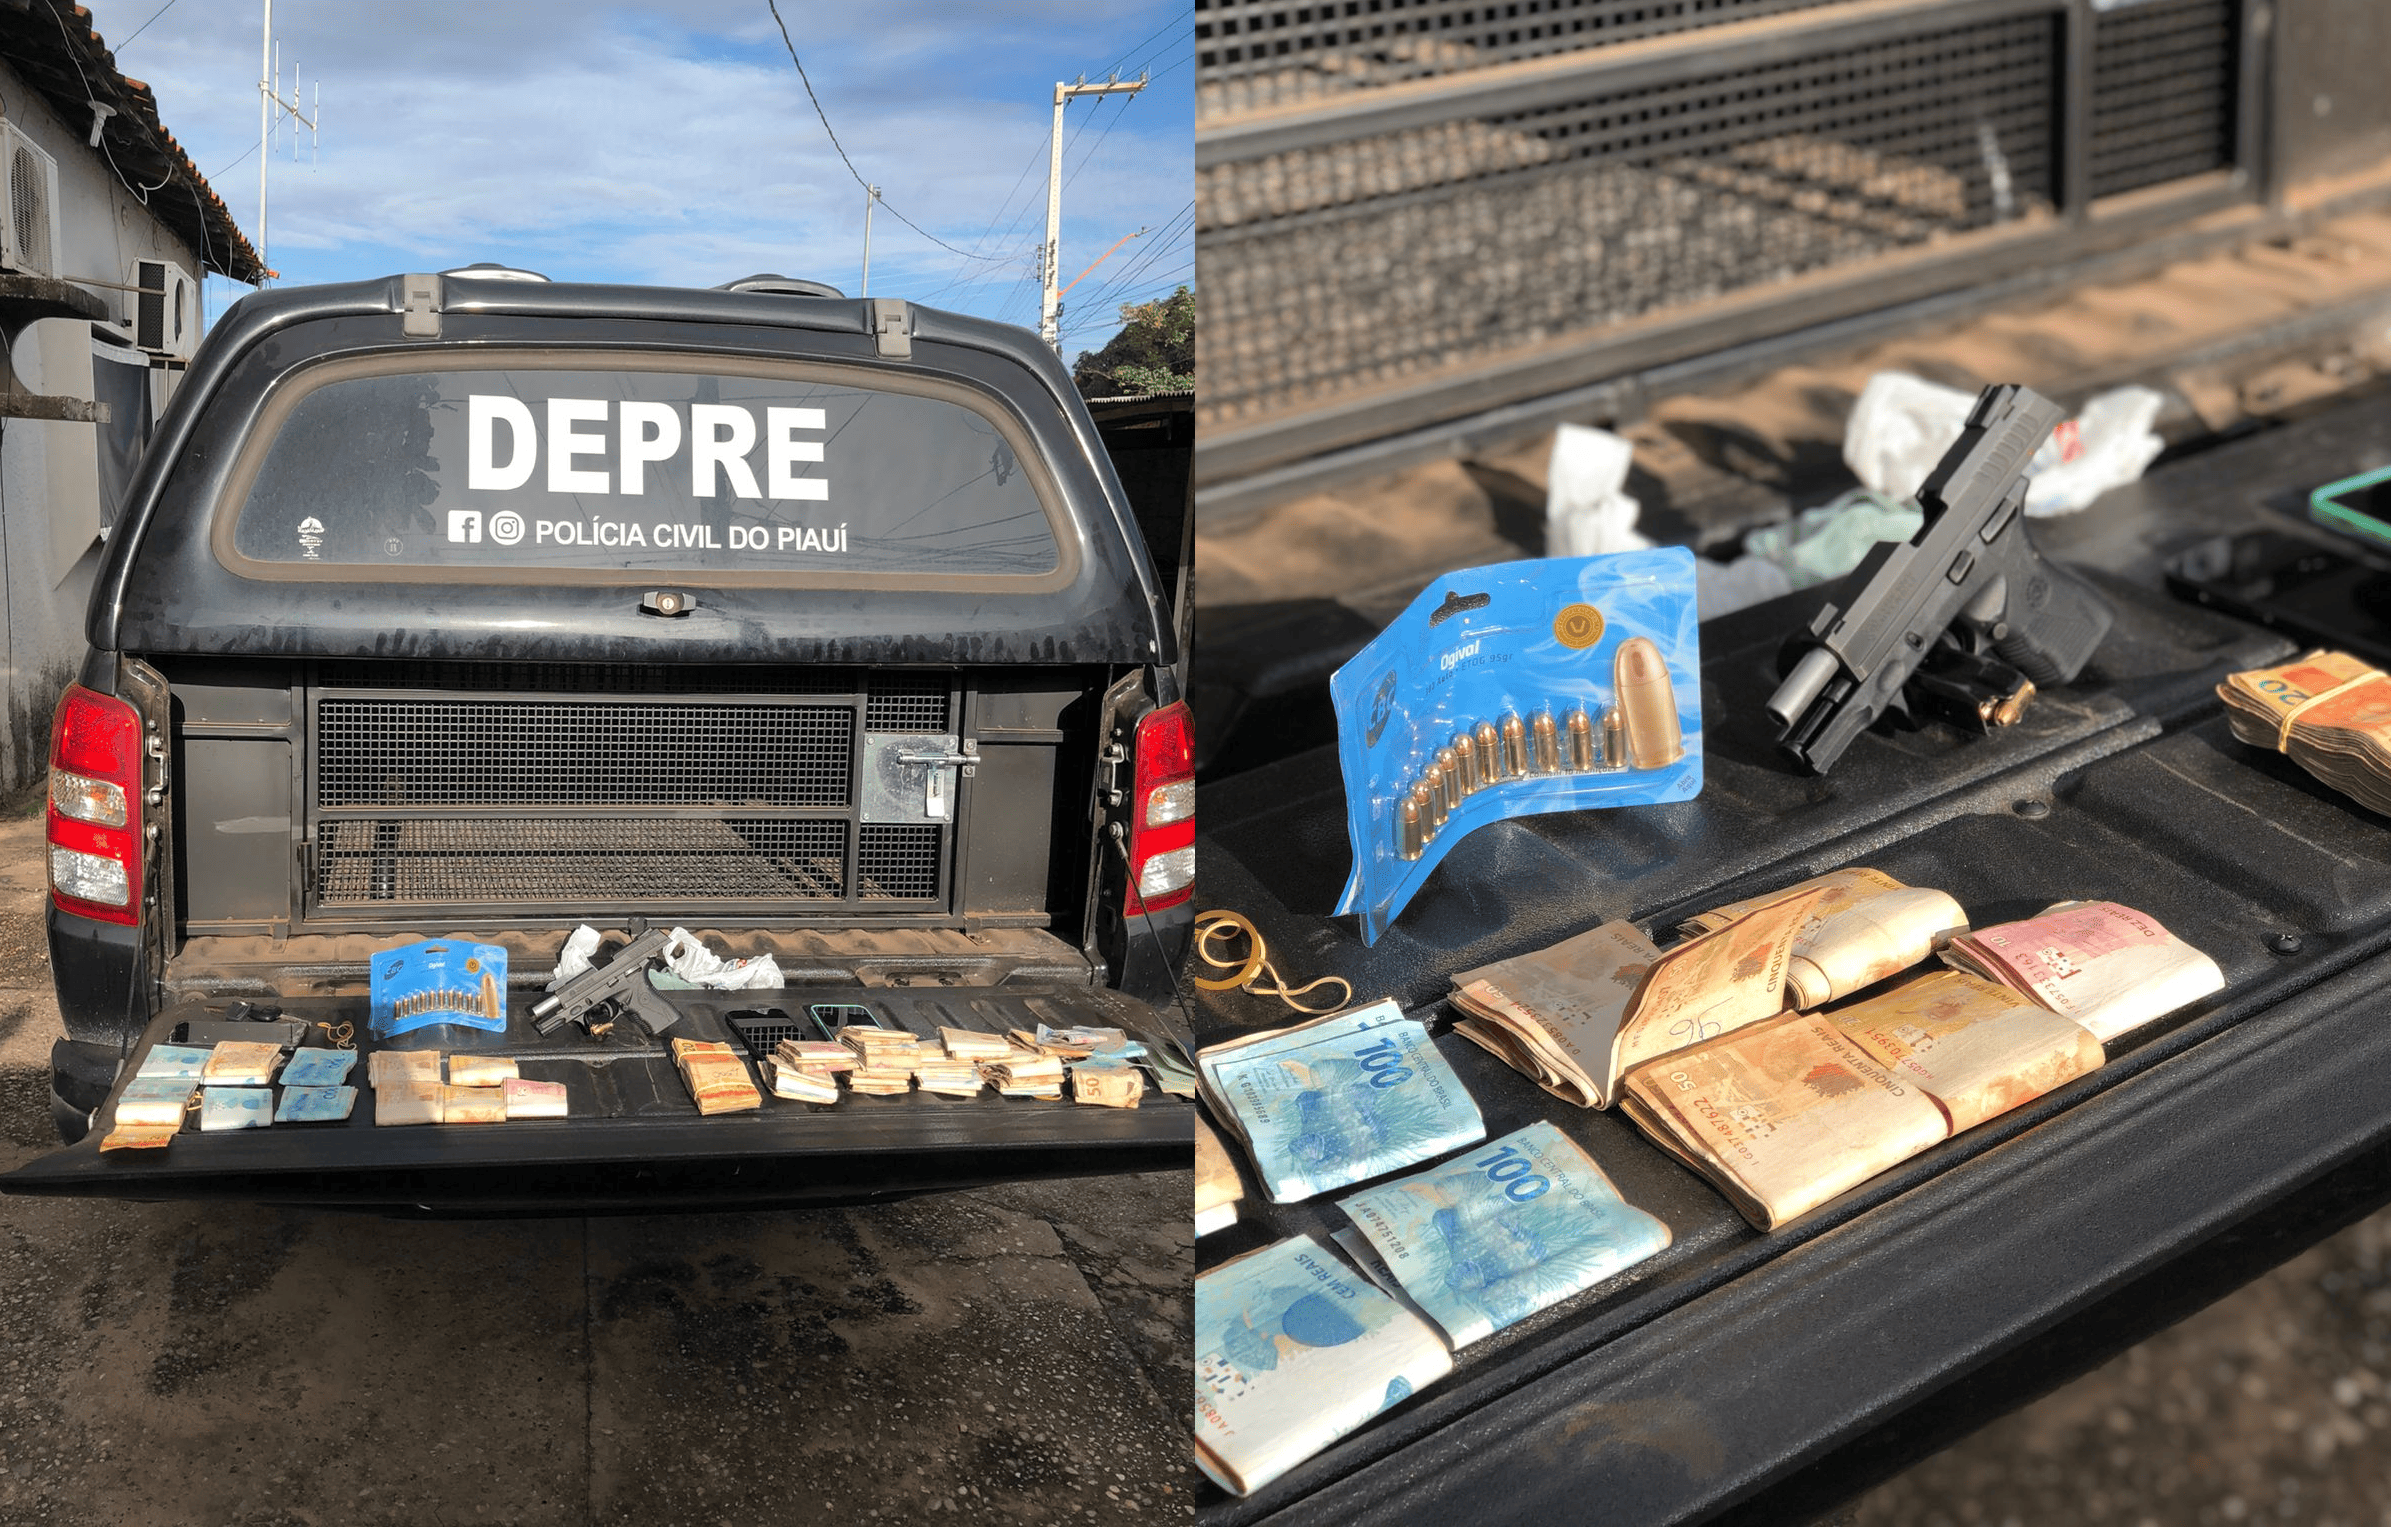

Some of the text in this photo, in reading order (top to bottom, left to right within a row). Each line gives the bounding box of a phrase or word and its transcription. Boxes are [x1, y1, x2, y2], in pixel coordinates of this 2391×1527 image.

[469, 394, 829, 501] DEPRE
[536, 515, 848, 553] POLÍCIA CIVIL DO PIAUÍ
[1441, 640, 1480, 670] Ogival
[2258, 679, 2310, 706] 20
[2130, 919, 2155, 937] DEZ
[1353, 1037, 1413, 1089] 100
[1670, 1071, 1697, 1092] 50
[1810, 1025, 1905, 1097] CINQUENTA REAIS
[1085, 1077, 1102, 1097] 50
[1432, 1086, 1452, 1110] BRASIL
[1477, 1146, 1551, 1203] 100
[1516, 1136, 1544, 1159] BANCO
[1538, 1156, 1571, 1189] CENTRAL
[1567, 1188, 1584, 1200] DO
[1354, 1201, 1409, 1259] JA074751208
[1293, 1252, 1356, 1299] CEM REAIS
